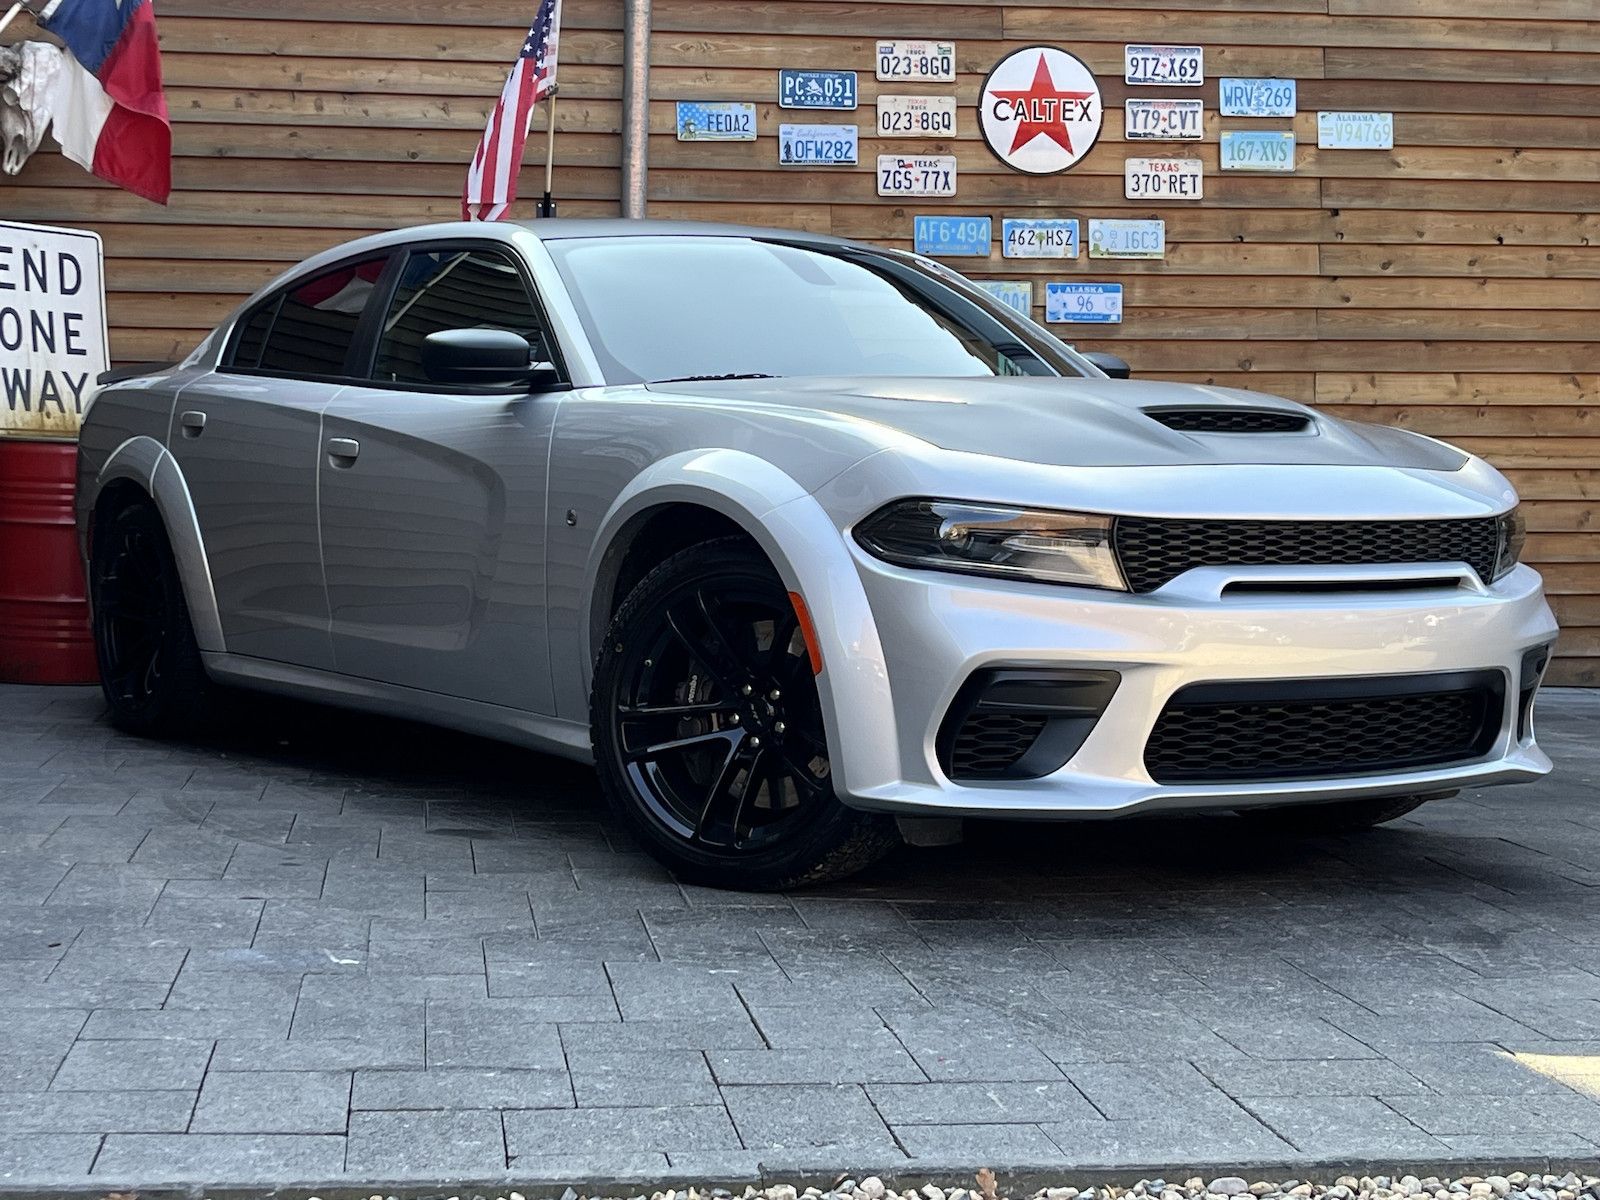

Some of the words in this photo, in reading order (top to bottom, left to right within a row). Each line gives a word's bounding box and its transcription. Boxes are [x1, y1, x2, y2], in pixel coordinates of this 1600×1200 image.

[881, 56, 912, 75] 023
[920, 56, 950, 76] 8GQ
[1130, 57, 1161, 77] 9TZ
[1168, 57, 1198, 78] X69
[785, 76, 804, 95] PC
[824, 78, 853, 97] 051
[1223, 86, 1254, 107] WRV
[1264, 87, 1292, 108] 269
[882, 111, 912, 131] 023
[920, 111, 951, 131] 8GQ
[993, 99, 1093, 122] CALTEX
[1131, 109, 1161, 130] Y79
[1168, 109, 1199, 130] CVT
[1336, 114, 1375, 122] ALABAMA
[1335, 123, 1391, 142] V94769
[914, 160, 938, 168] TEXAS
[1148, 162, 1180, 172] TEXAS
[882, 170, 913, 190] ZGS
[920, 170, 951, 191] 77X
[1131, 173, 1161, 193] 370
[1169, 174, 1199, 194] RET
[1008, 229, 1035, 246] 462
[1046, 229, 1073, 246] HSZ
[0, 246, 82, 296] END
[1064, 286, 1104, 294] ALASKA
[1077, 295, 1094, 312] 96
[0, 306, 87, 356] ONE
[1, 366, 89, 414] WAY
